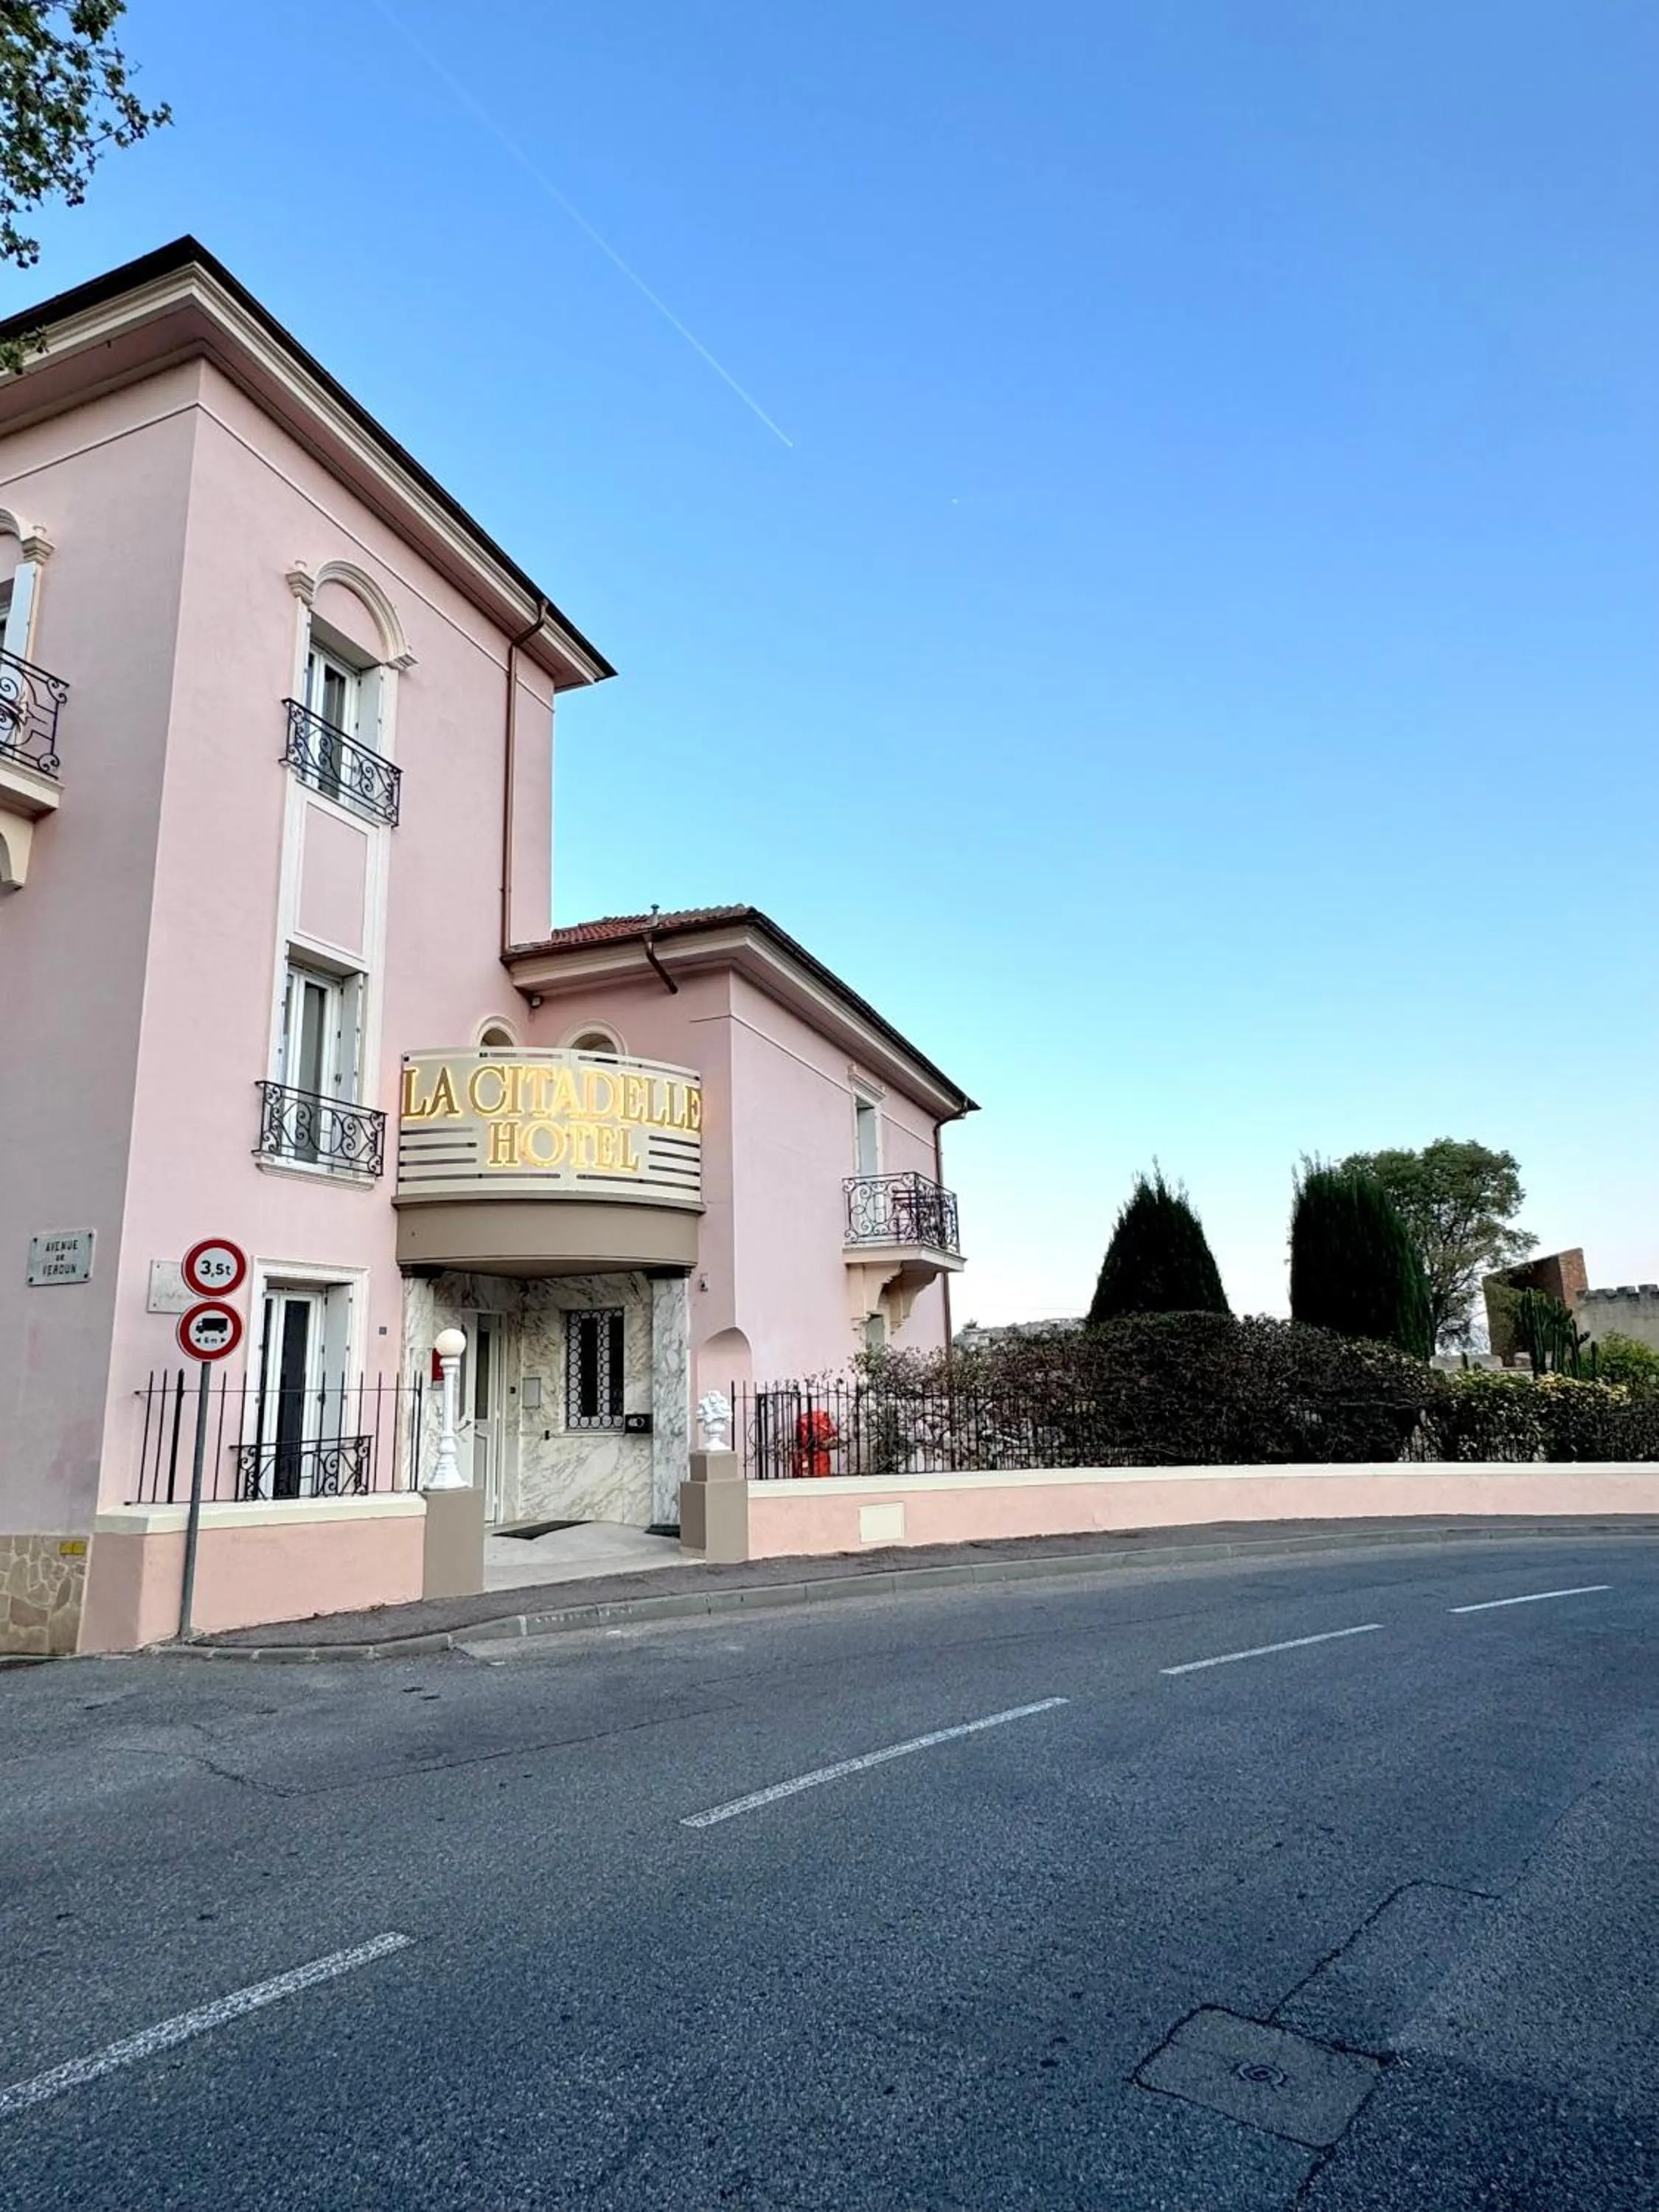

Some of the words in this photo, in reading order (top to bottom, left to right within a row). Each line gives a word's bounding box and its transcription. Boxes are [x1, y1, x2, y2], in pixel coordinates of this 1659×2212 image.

[402, 1065, 460, 1119] LA
[468, 1064, 701, 1131] CITADELLE
[488, 1119, 640, 1172] HOTEL
[46, 1240, 79, 1251] AVENUE
[43, 1263, 77, 1276] VERDUN
